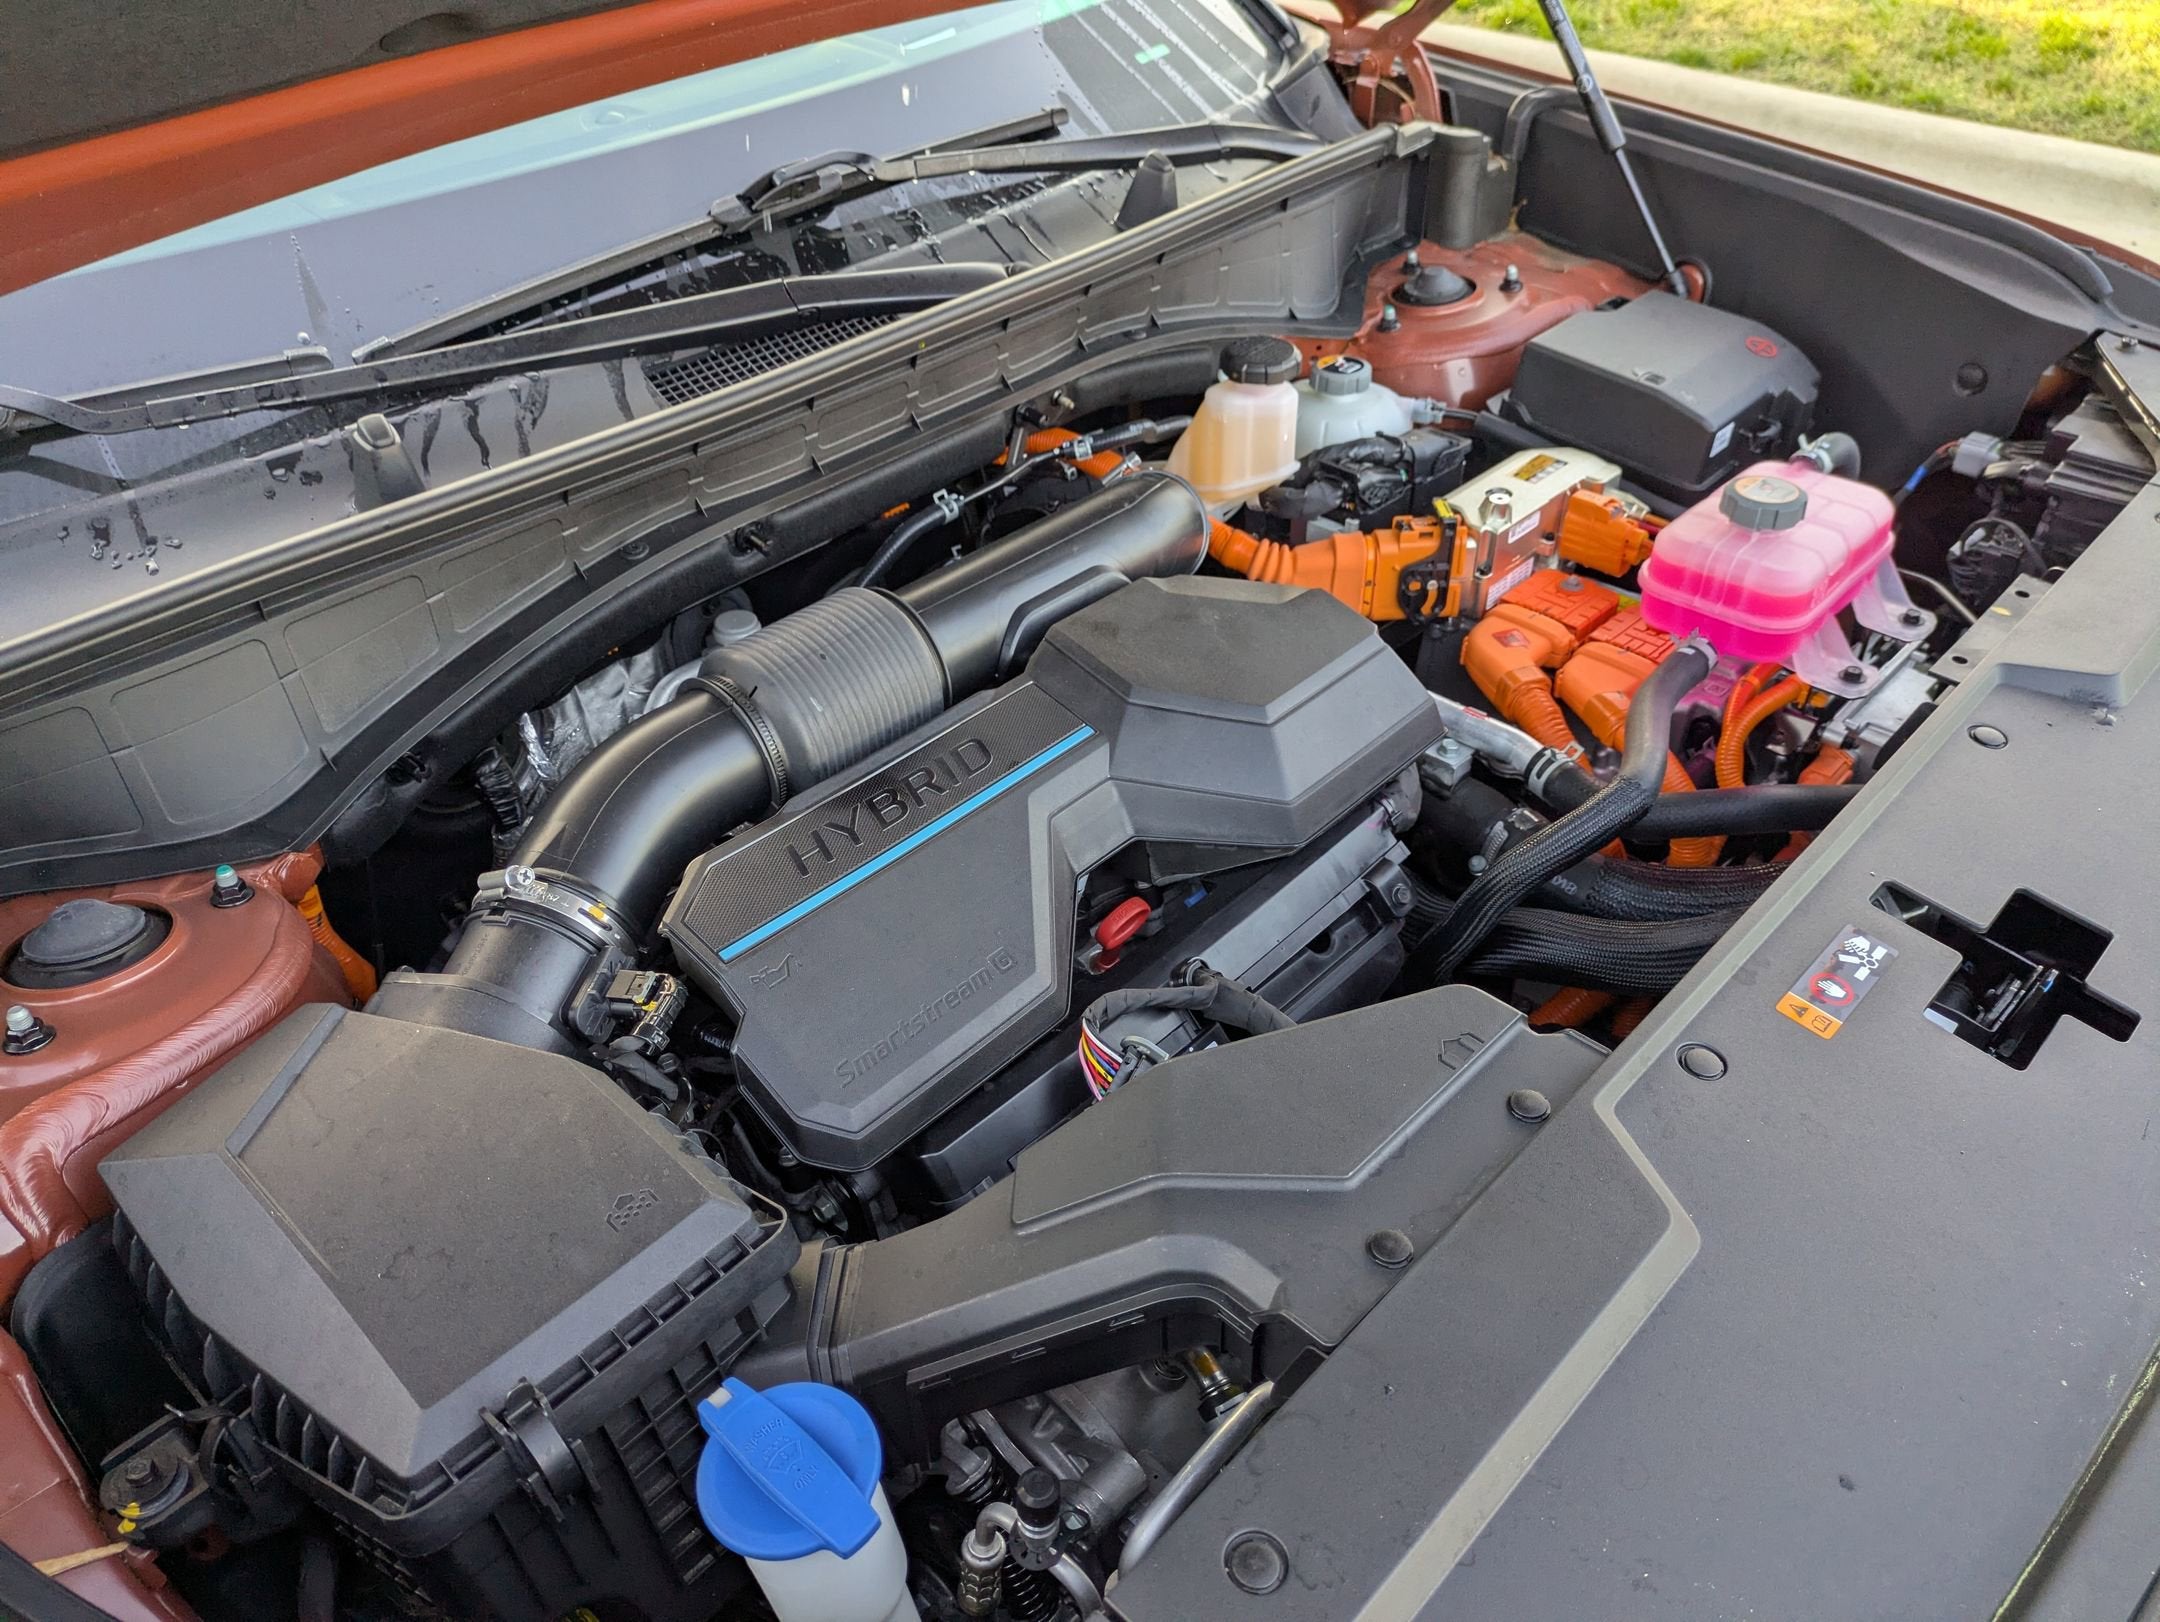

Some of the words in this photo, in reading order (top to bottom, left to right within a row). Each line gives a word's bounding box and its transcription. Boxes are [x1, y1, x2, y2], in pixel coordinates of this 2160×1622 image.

[785, 738, 993, 877] HYBRID
[834, 966, 993, 1088] Smartstream
[986, 946, 1017, 973] G
